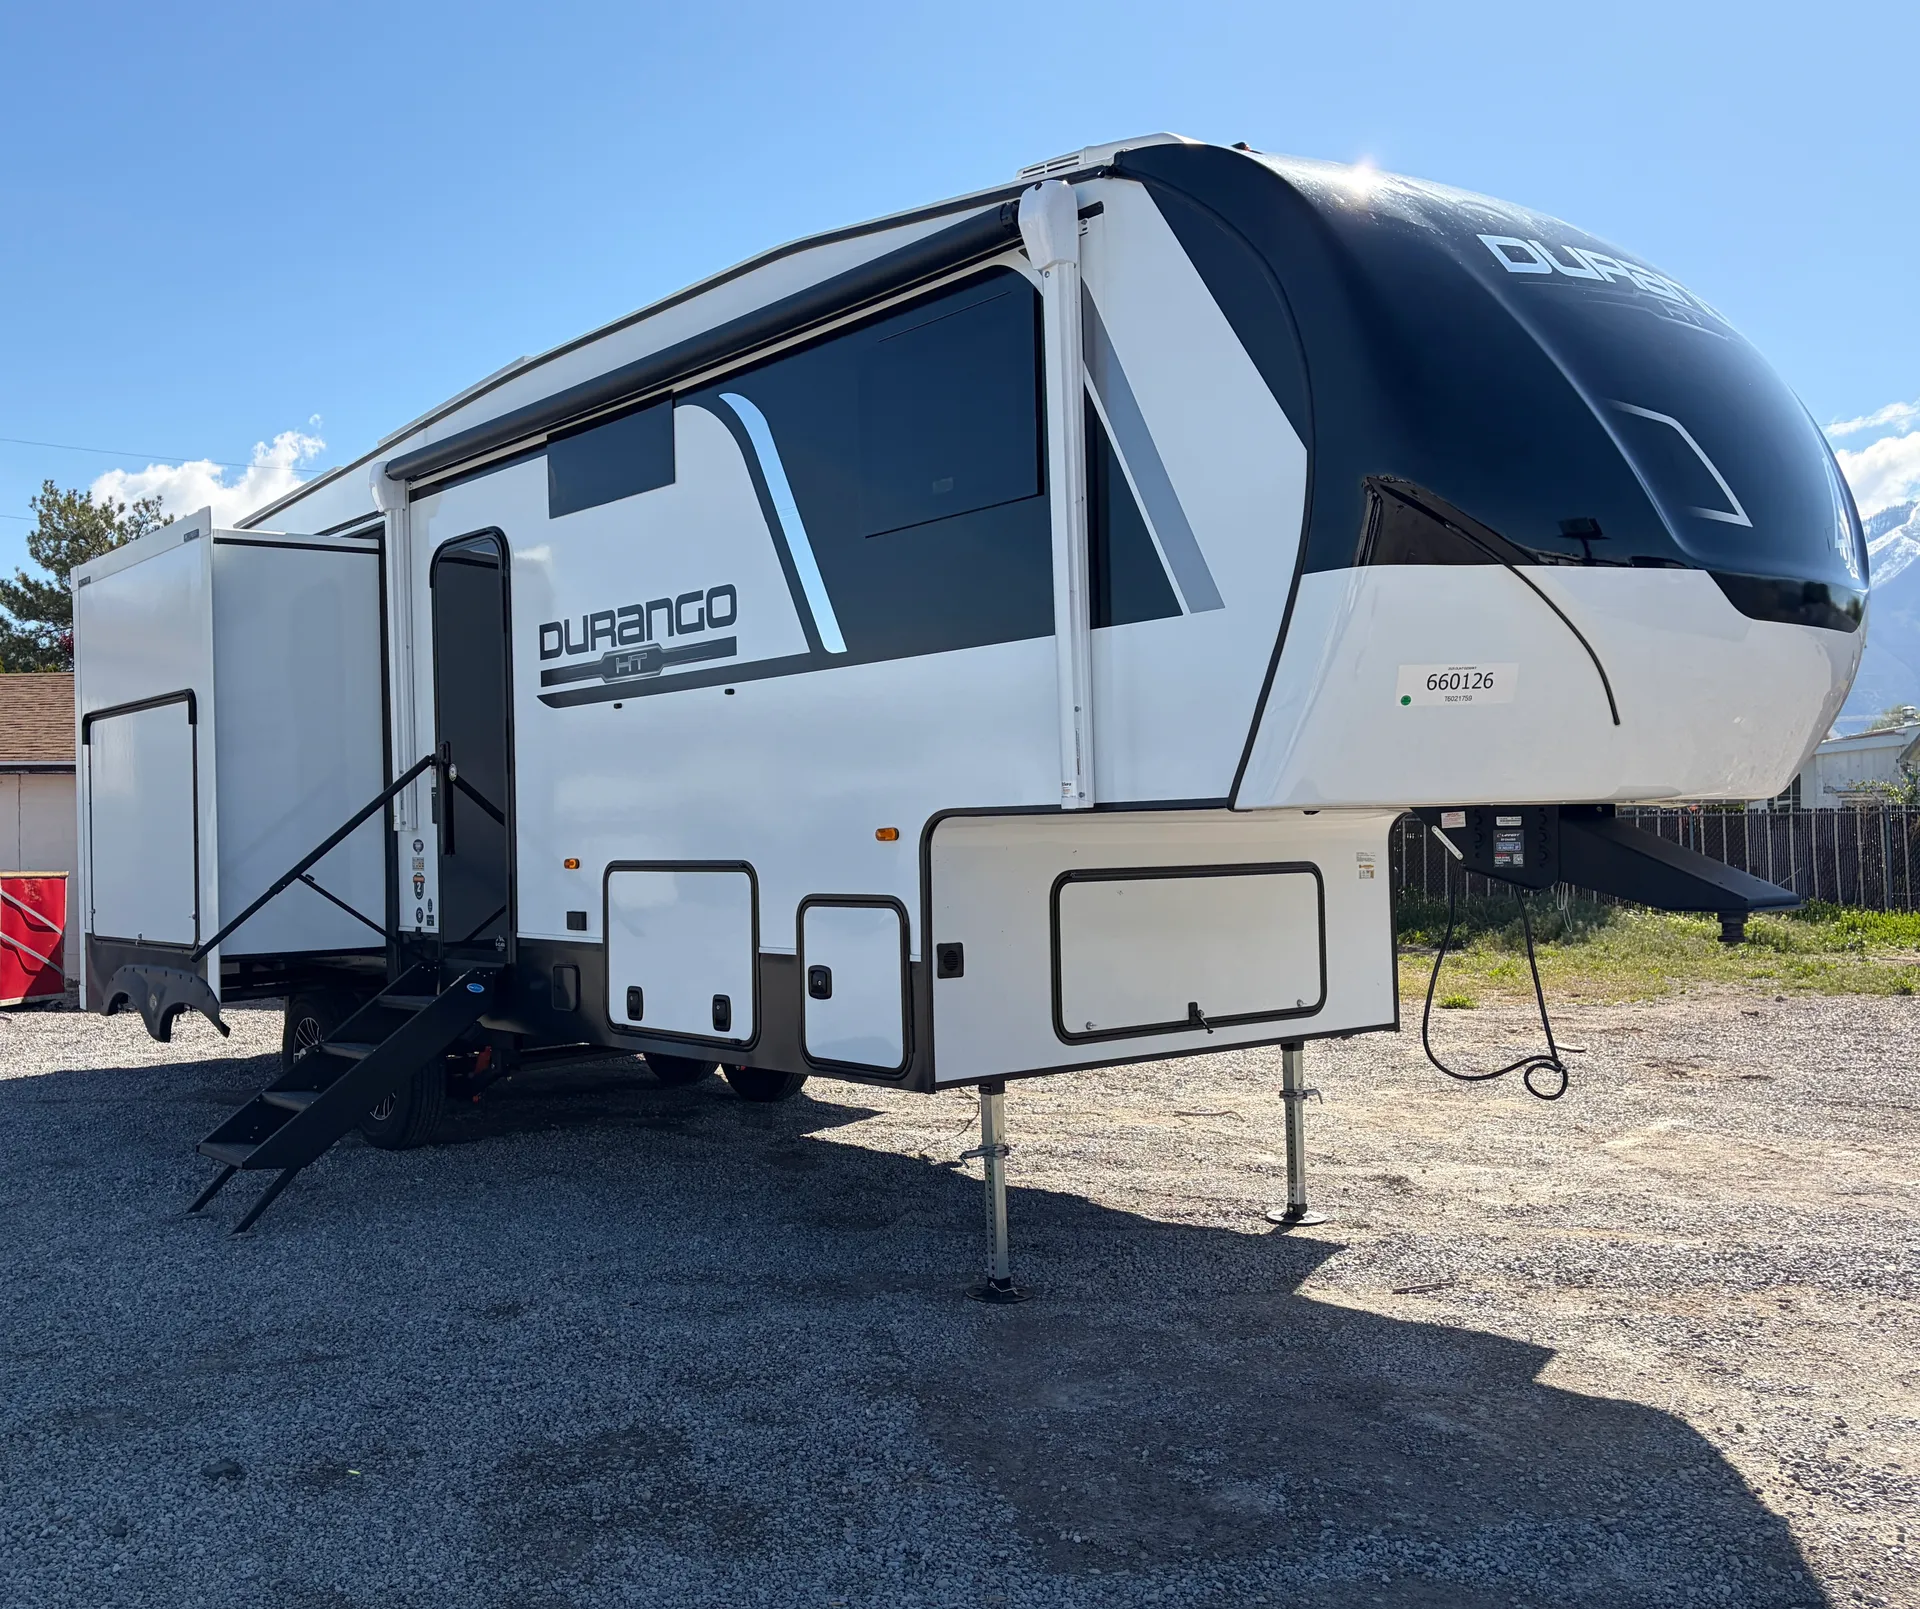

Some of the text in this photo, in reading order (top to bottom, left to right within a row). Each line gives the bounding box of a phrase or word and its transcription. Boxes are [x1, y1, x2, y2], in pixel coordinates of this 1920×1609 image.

[1476, 234, 1734, 326] DURAN
[539, 583, 738, 661] DURANGO
[615, 652, 648, 674] HT
[1426, 672, 1494, 691] 660126
